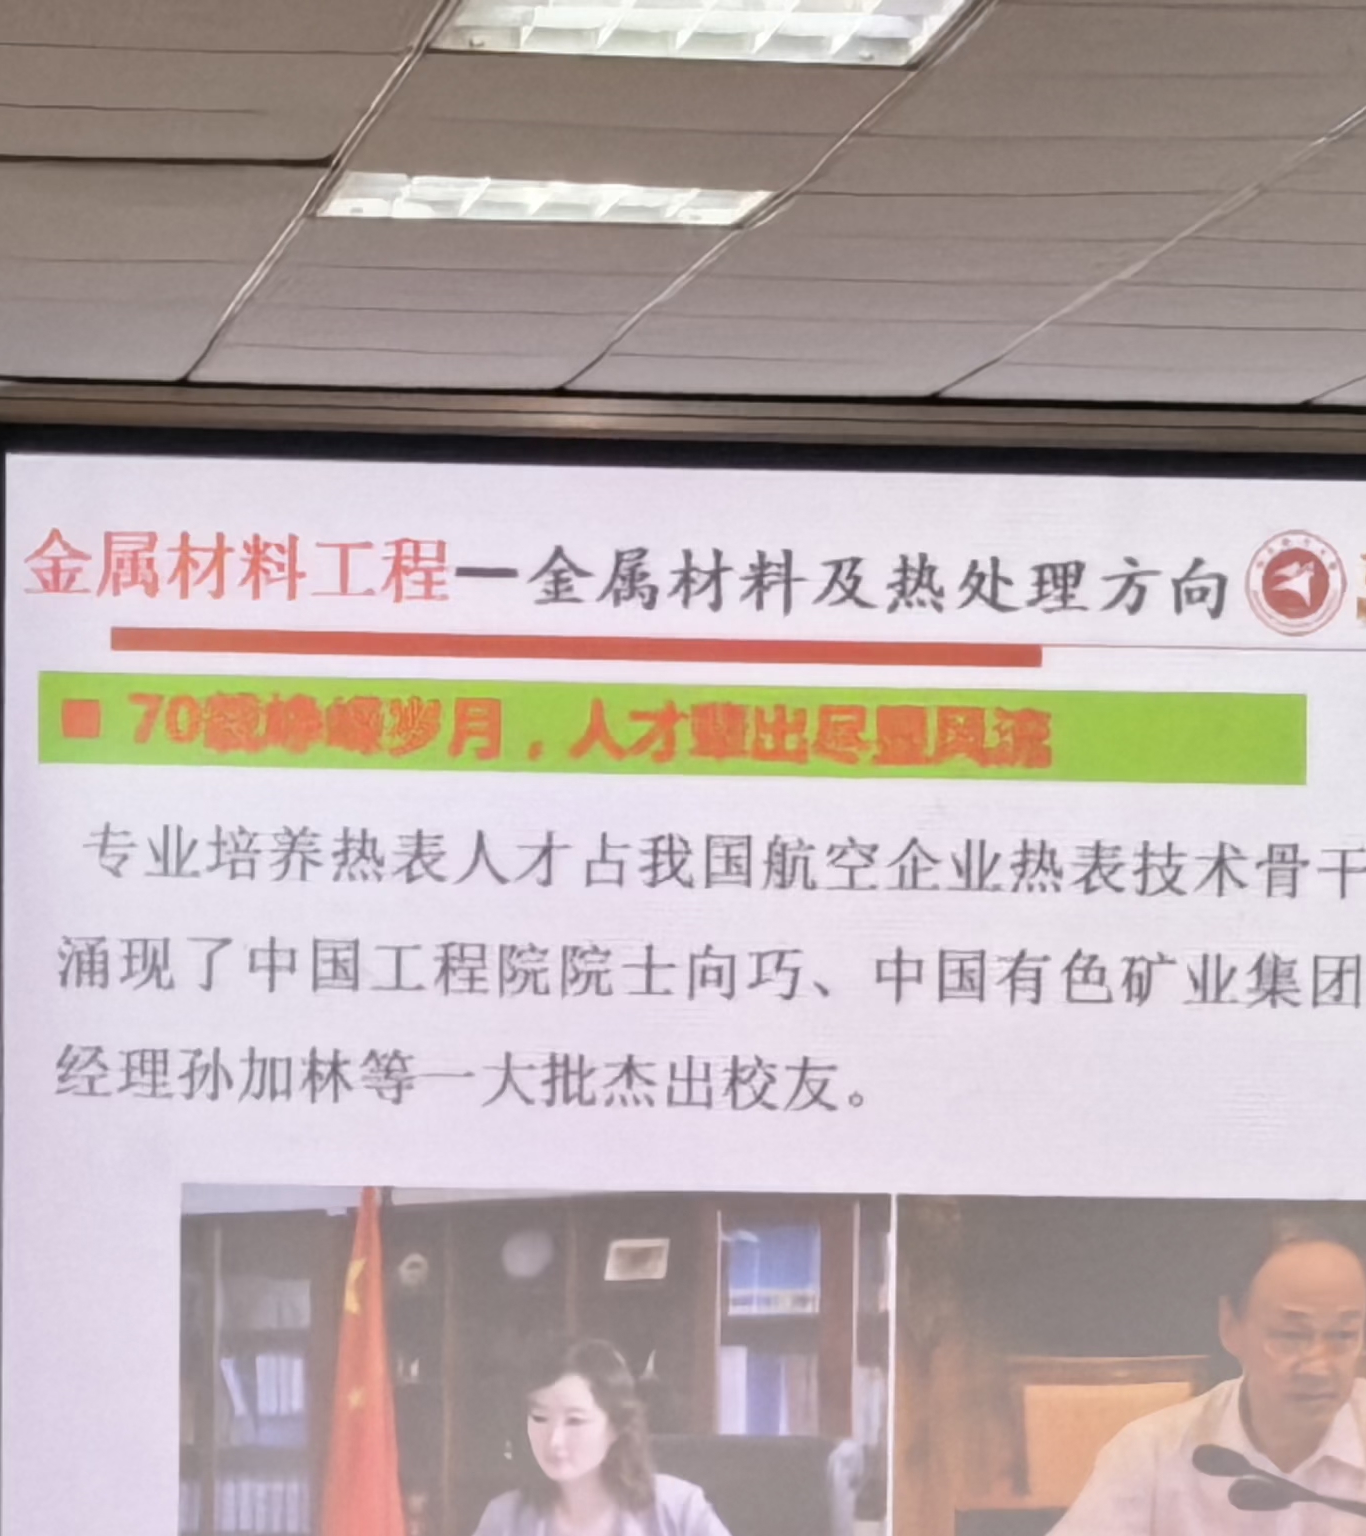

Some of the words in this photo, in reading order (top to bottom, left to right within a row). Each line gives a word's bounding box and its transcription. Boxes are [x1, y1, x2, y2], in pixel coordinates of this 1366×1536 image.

[54, 1043, 865, 1112] 经理孙加林等一大批杰出校友。
